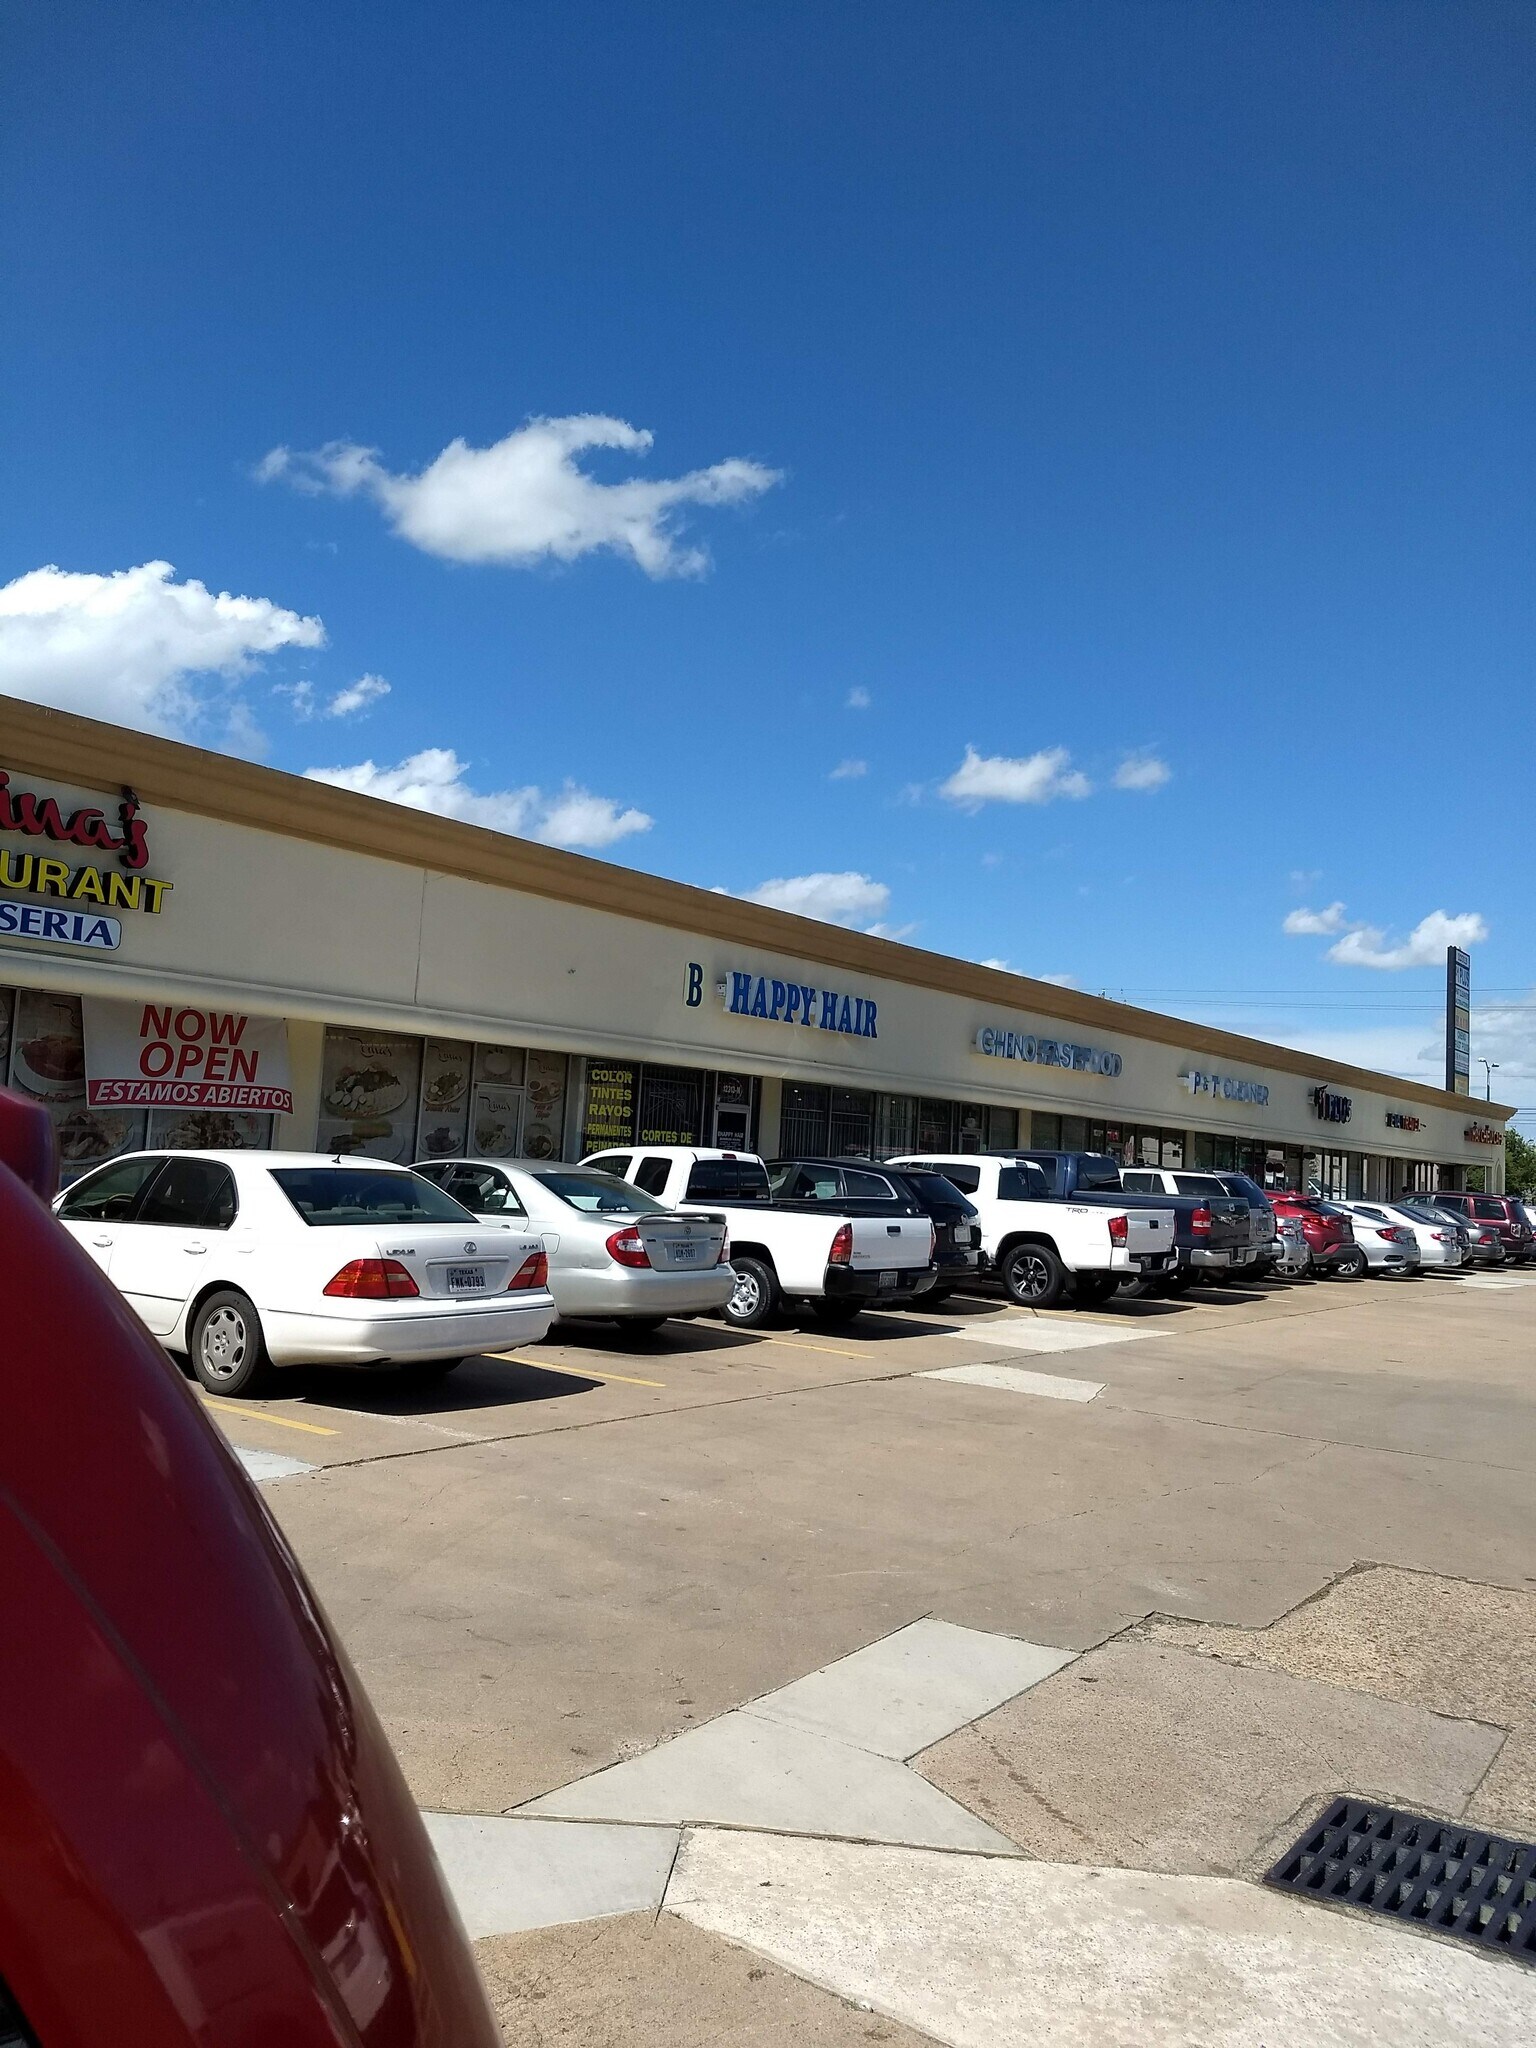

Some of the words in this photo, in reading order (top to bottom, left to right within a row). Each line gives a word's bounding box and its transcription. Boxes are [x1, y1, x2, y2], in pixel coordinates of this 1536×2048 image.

[0, 849, 174, 914] URANT
[0, 903, 114, 946] SERIA
[686, 962, 703, 1007] B
[730, 972, 815, 1027] HAPPY
[820, 990, 878, 1039] HAIR
[139, 1004, 248, 1046] NOW
[139, 1041, 259, 1083] OPEN
[591, 1069, 632, 1084] COLOR
[95, 1081, 199, 1103] ESTAMOS
[203, 1083, 292, 1109] ABIERTOS
[591, 1087, 632, 1101] TINTES
[589, 1104, 631, 1117] RAYOS
[587, 1123, 632, 1137] PERMANENTES
[641, 1129, 678, 1143] CORTES
[681, 1131, 692, 1144] DE
